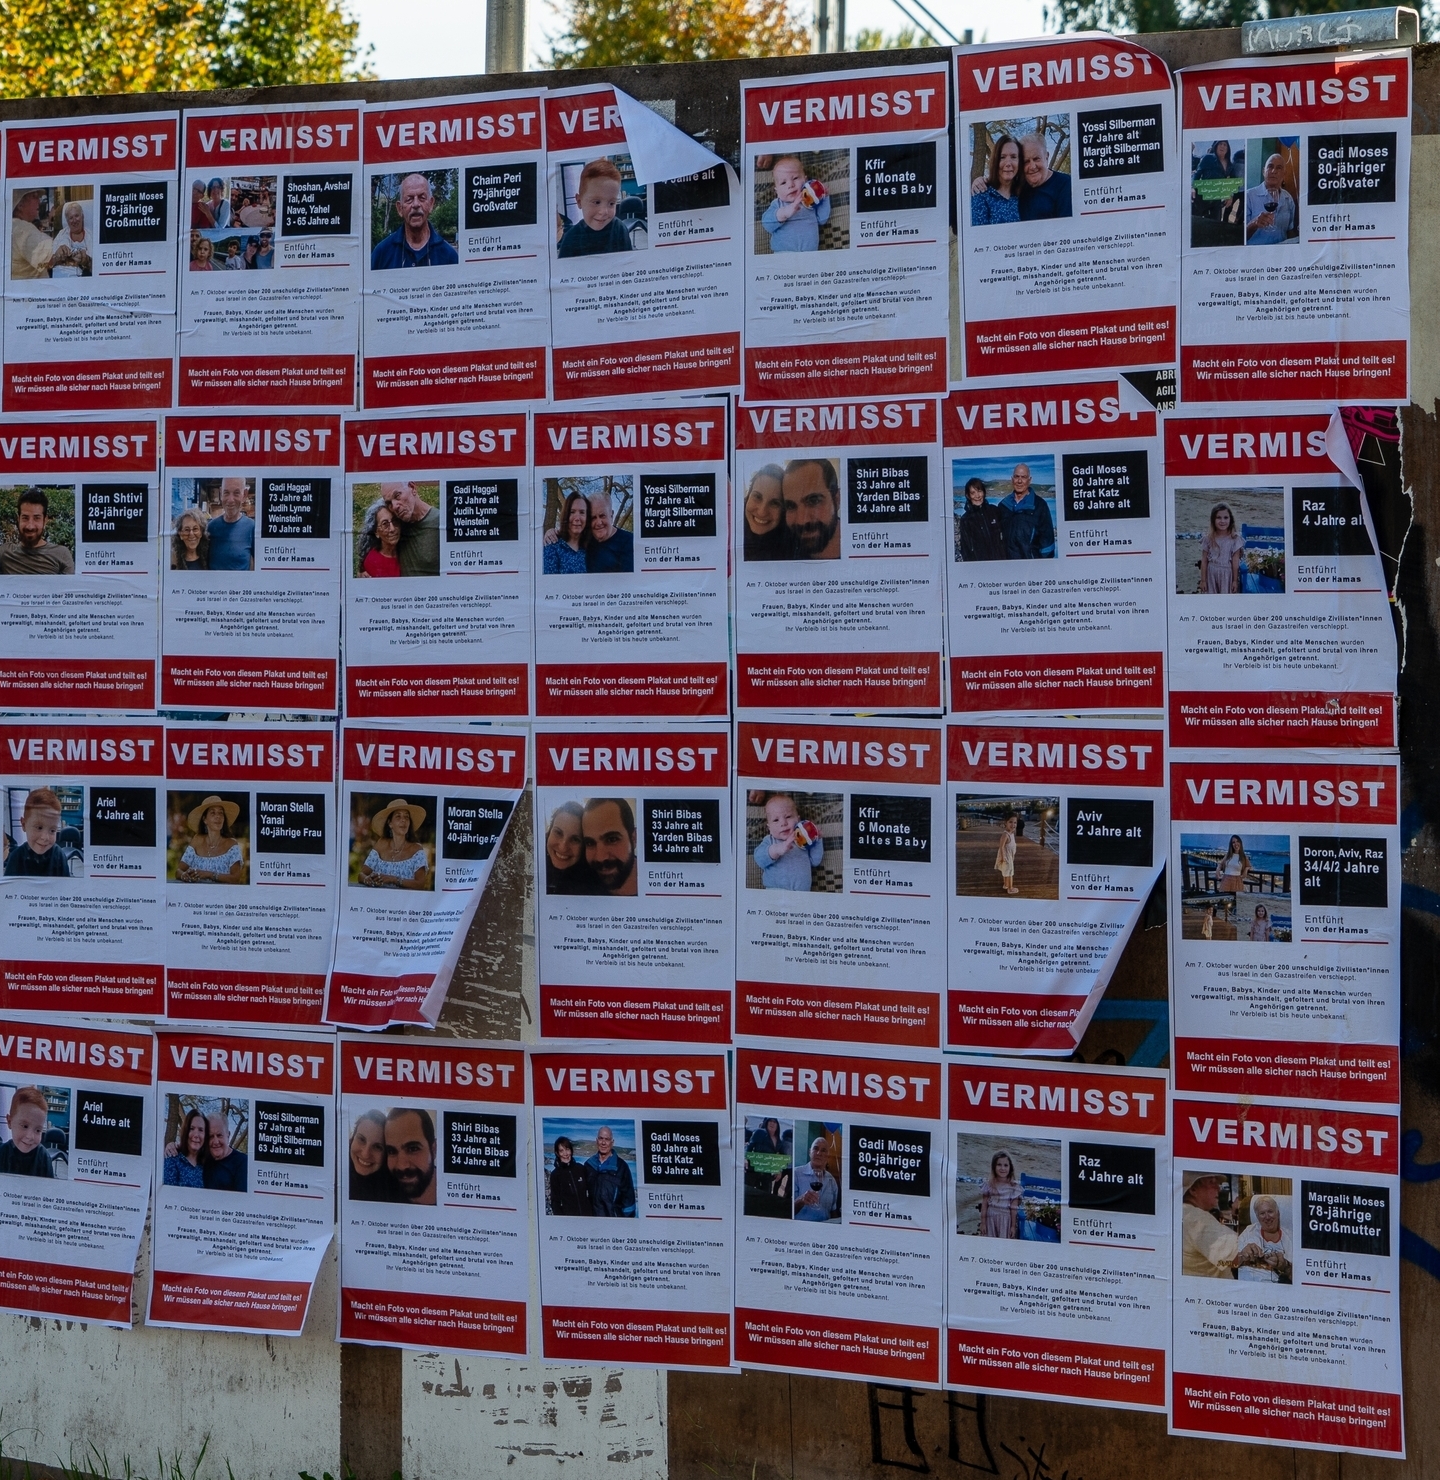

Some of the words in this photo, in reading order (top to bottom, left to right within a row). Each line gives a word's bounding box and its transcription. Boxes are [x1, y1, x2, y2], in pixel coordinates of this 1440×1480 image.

[972, 51, 1155, 92] VERMISST
[1197, 74, 1396, 111] VERMISST
[375, 111, 535, 147] VERMISST
[1082, 120, 1106, 132] Yossi
[1108, 117, 1155, 129] Silberman
[1082, 134, 1093, 144] 67
[1096, 132, 1123, 142] Jahre
[1126, 130, 1139, 139] alt
[18, 133, 167, 163] VERMISST
[1083, 144, 1112, 157] Margit
[1113, 141, 1160, 153] Silberman
[1318, 146, 1343, 159] Gadi
[1348, 146, 1388, 157] Moses
[865, 158, 885, 170] Kfir
[1083, 158, 1094, 168] 63
[1097, 156, 1124, 167] Jahre
[1127, 154, 1140, 164] alt
[1317, 161, 1385, 176] 80-jähriger
[864, 173, 871, 184] 6
[875, 170, 916, 183] Monate
[1317, 176, 1380, 189] Großvater
[864, 186, 896, 196] altes
[901, 183, 932, 194] Baby
[1156, 385, 1176, 396] AGIL
[177, 428, 331, 452] VERMISST
[547, 421, 714, 450] VERMISST
[88, 493, 109, 503] Idan
[113, 492, 142, 503] Shtivi
[88, 506, 143, 519] 28-jähriger
[88, 519, 114, 530] Mann
[1225, 638, 1248, 646] Babys,
[1277, 646, 1305, 654] gefoltert
[1242, 654, 1286, 662] Angehörigen
[7, 738, 154, 761] VERMISST
[548, 747, 717, 771] VERMISST
[1185, 778, 1385, 807] VERMISST
[170, 1045, 324, 1078] VERMISST
[1186, 1051, 1214, 1060] Macht
[1215, 1052, 1229, 1061] ein
[1232, 1053, 1252, 1062] Foto
[1274, 1055, 1307, 1064] diesem
[1309, 1056, 1336, 1066] Plakat
[1338, 1058, 1356, 1066] und
[1357, 1058, 1375, 1067] teilt
[1376, 1059, 1390, 1068] es!
[353, 1056, 514, 1087] VERMISST
[1190, 1063, 1206, 1072] Wir
[1208, 1064, 1244, 1073] müssen
[1246, 1065, 1262, 1074] alle
[1264, 1066, 1293, 1075] sicher
[1295, 1068, 1317, 1077] nach
[1319, 1068, 1347, 1078] Hause
[1349, 1070, 1386, 1081] bringen!
[82, 1100, 102, 1112] Ariel
[963, 1080, 1154, 1117] VERMISST
[82, 1113, 88, 1123] 4
[90, 1114, 116, 1126] Jahre
[118, 1117, 130, 1128] alt
[451, 1121, 472, 1131] Shiri
[474, 1123, 499, 1133] Bibas
[451, 1133, 461, 1142] 33
[463, 1134, 487, 1143] Jahre
[489, 1136, 500, 1144] alt
[1188, 1116, 1388, 1156] VERMISST
[451, 1144, 481, 1154] Yarden
[484, 1146, 508, 1157] Bibas
[451, 1155, 461, 1164] 34
[463, 1156, 487, 1166] Jahre
[489, 1158, 500, 1167] alt
[1308, 1191, 1349, 1204] Margalit
[1353, 1195, 1384, 1207] Moses
[1308, 1204, 1371, 1222] 78-jährige
[1308, 1219, 1381, 1236] Großmutter
[1305, 1258, 1346, 1270] Entführt
[1341, 1271, 1371, 1281] Hamas
